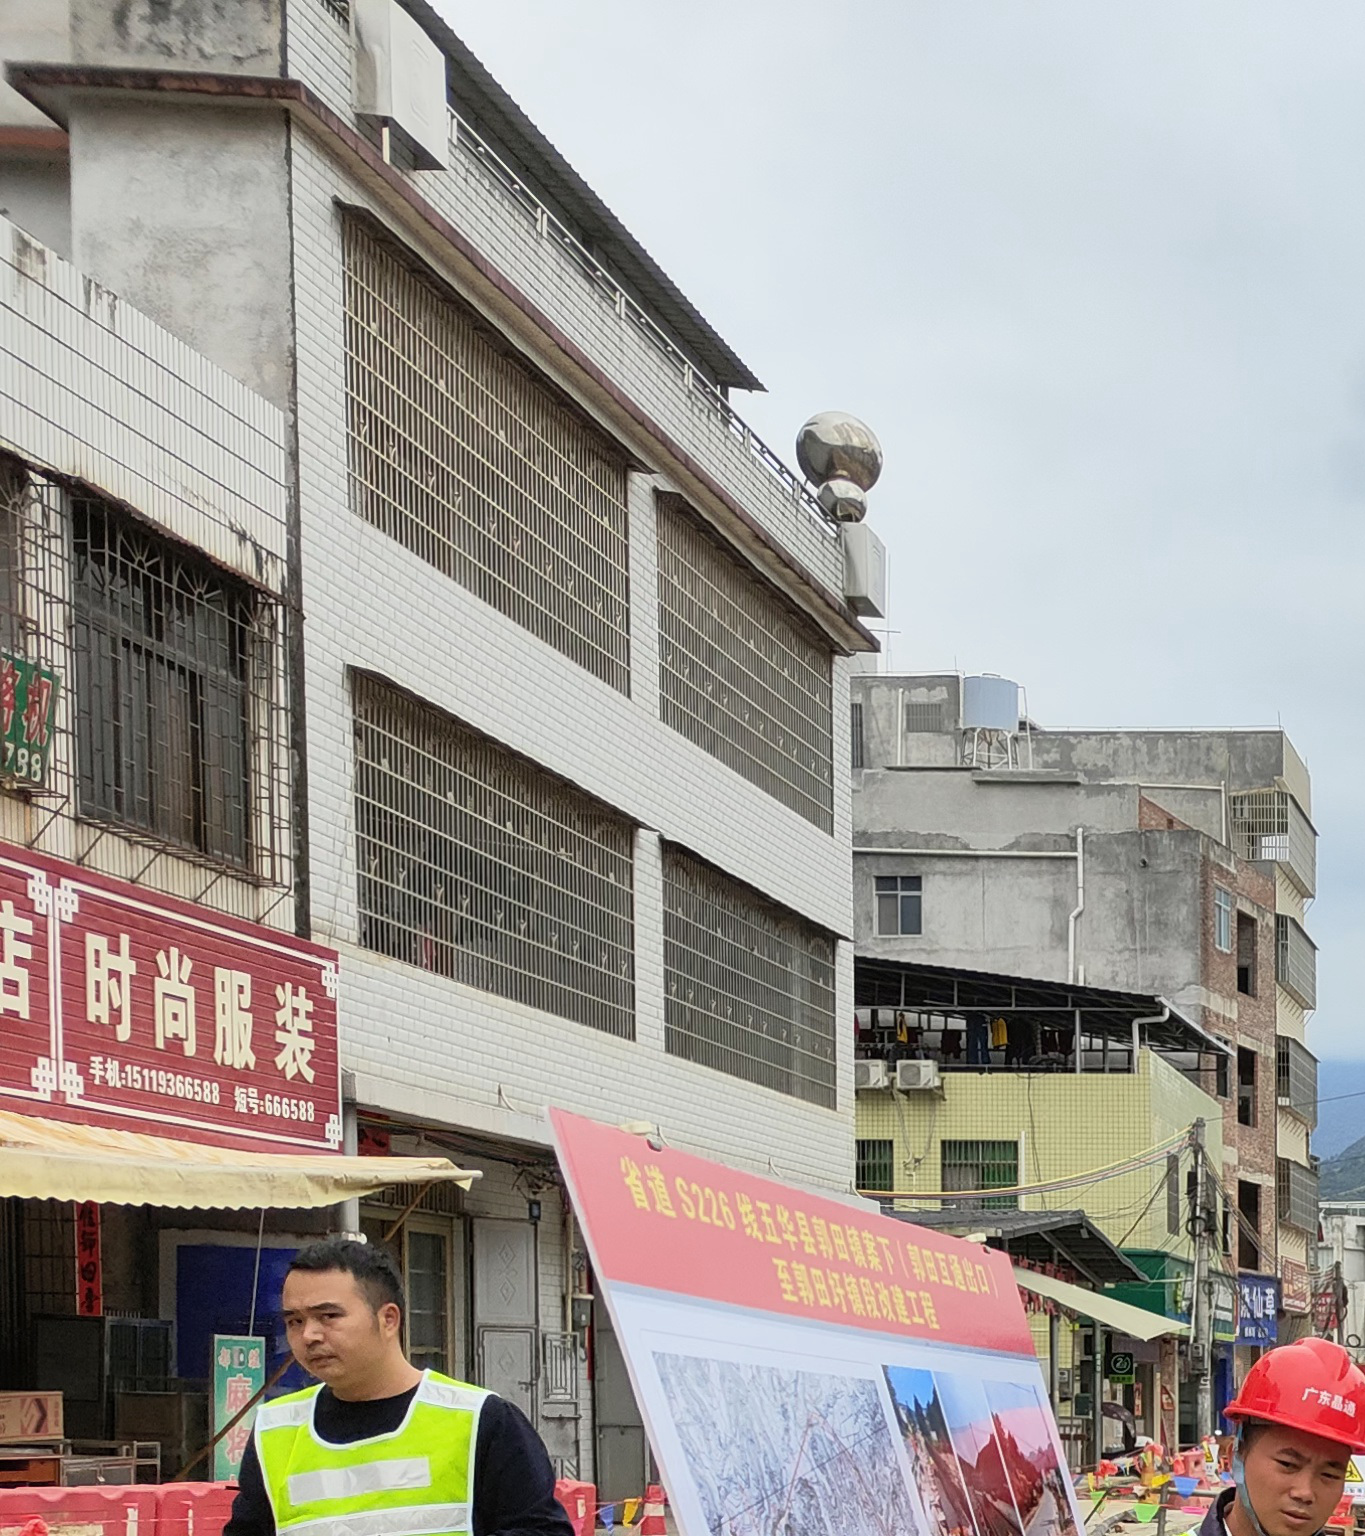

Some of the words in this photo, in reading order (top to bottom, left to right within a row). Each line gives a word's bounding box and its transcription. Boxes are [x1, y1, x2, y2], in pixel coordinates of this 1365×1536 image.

[0, 900, 33, 1020] 店
[85, 932, 316, 1084] 时尚服装
[620, 1156, 677, 1219] 省道
[674, 1176, 736, 1231] S226
[771, 1257, 941, 1330] 至郭田圩镇段改建工程
[1302, 1386, 1357, 1419] 广东晶通
